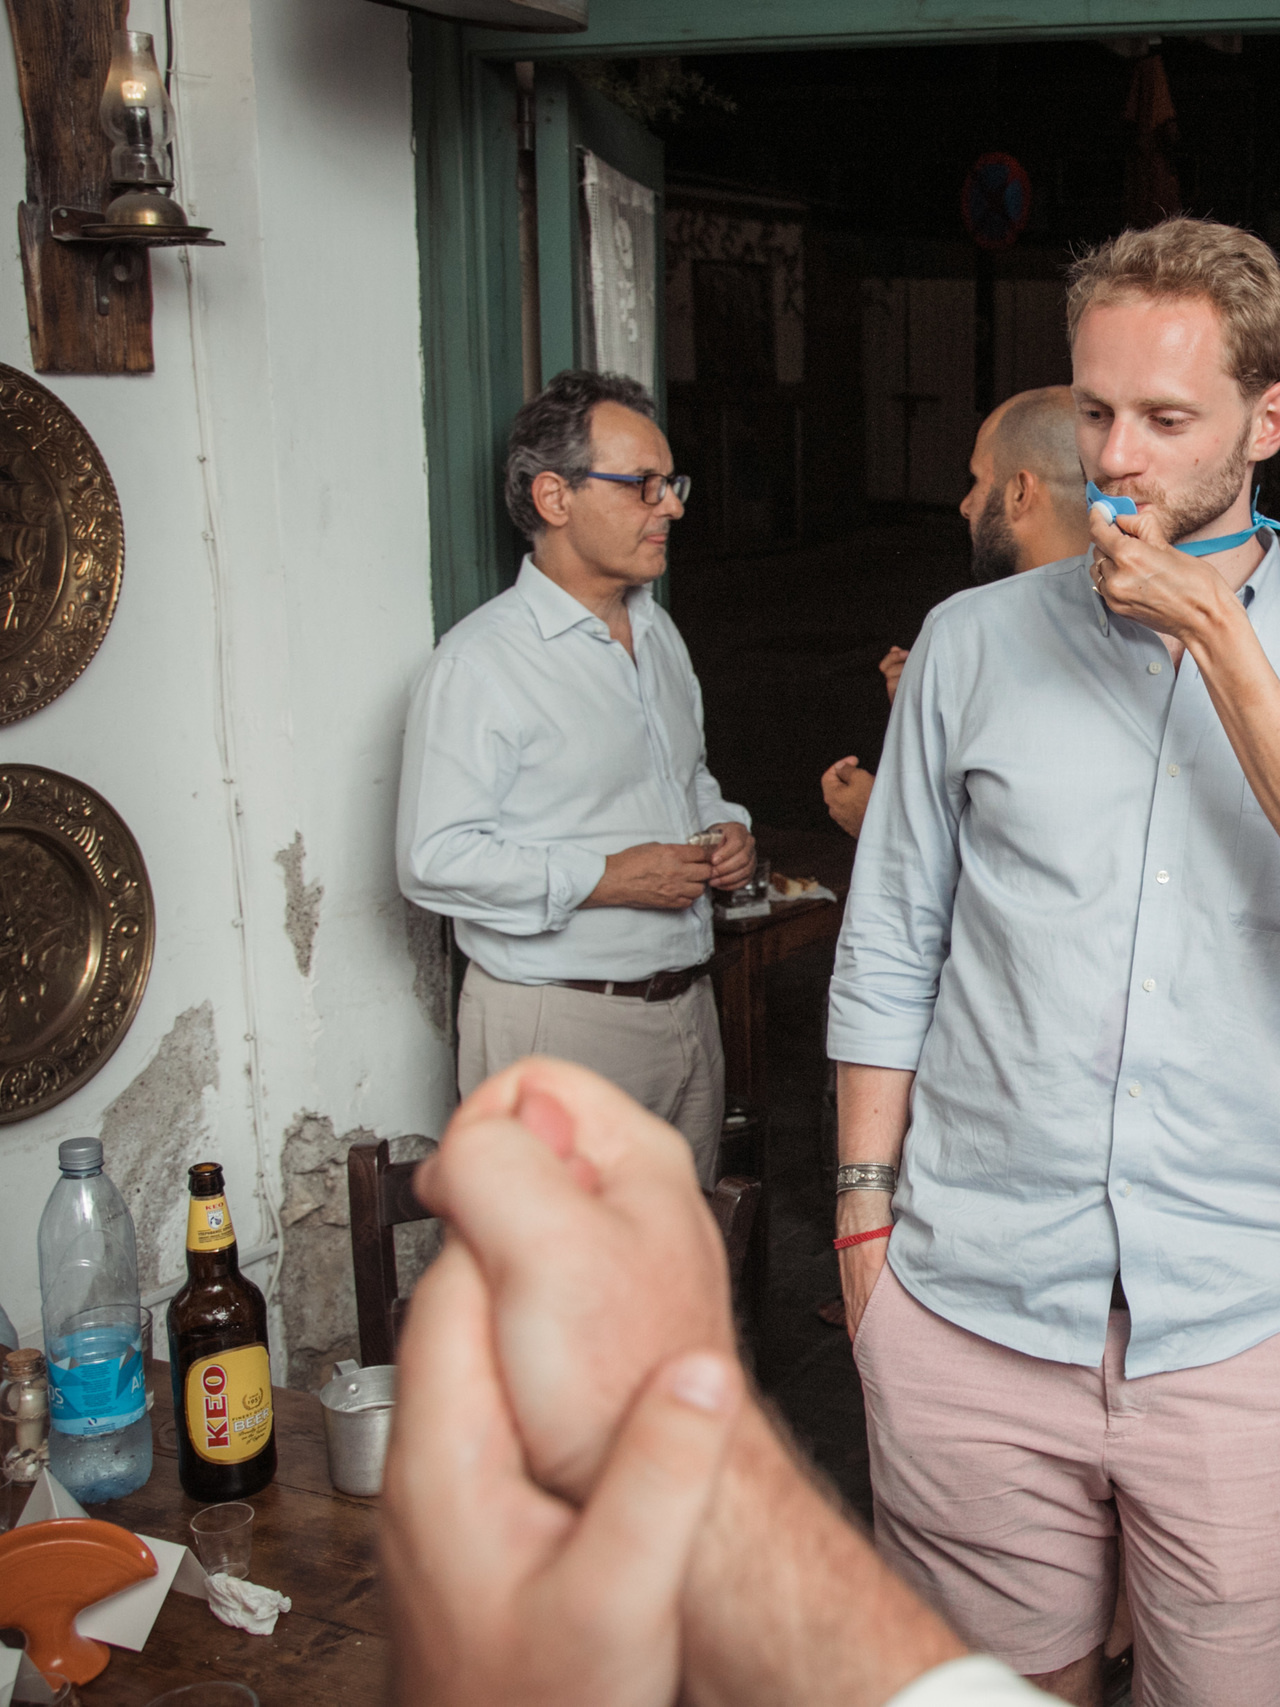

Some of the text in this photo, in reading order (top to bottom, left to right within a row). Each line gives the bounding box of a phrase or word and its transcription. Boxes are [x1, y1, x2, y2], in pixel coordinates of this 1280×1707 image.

[205, 1202, 224, 1210] KEO
[201, 1364, 231, 1449] KEO
[233, 1407, 270, 1432] BEER
